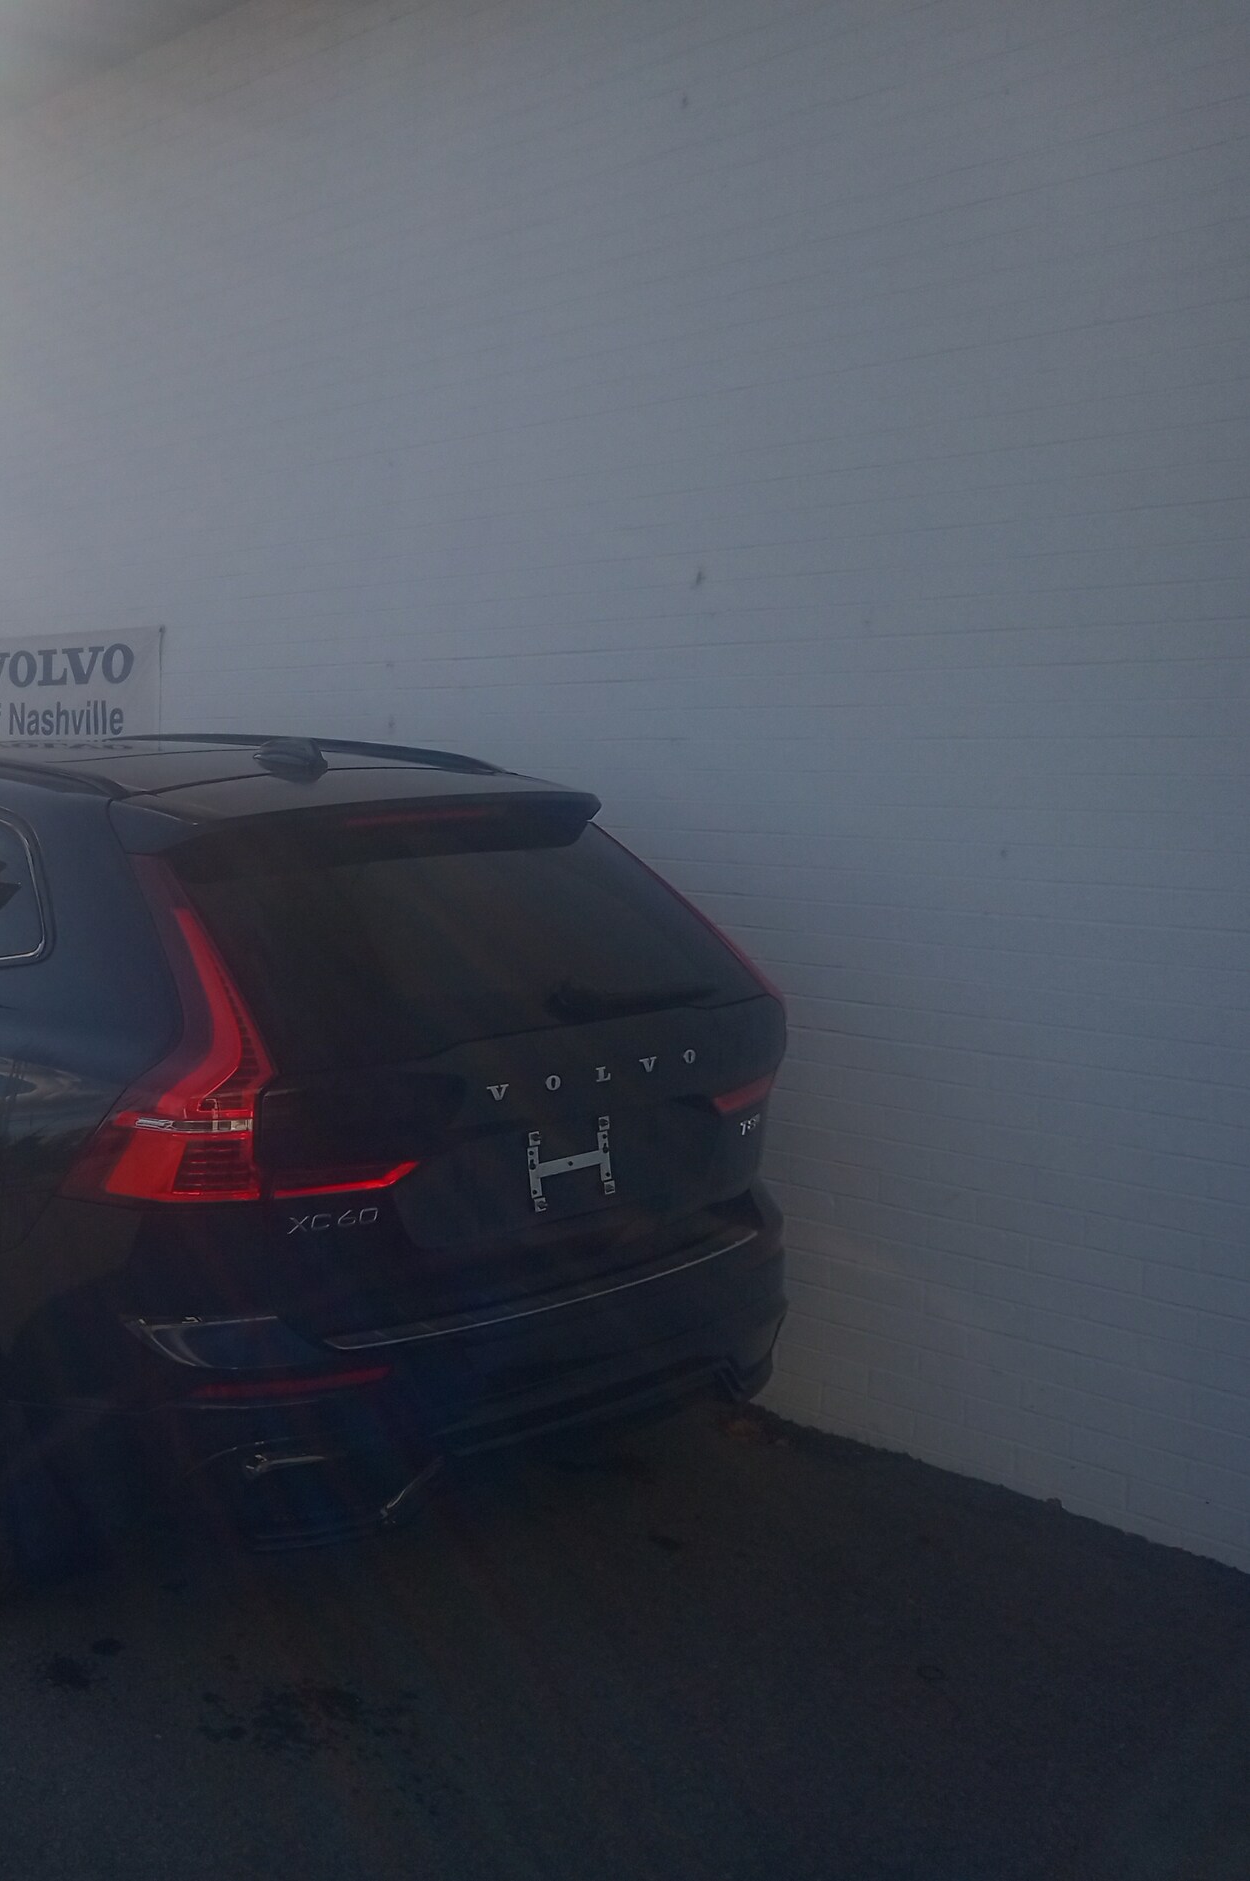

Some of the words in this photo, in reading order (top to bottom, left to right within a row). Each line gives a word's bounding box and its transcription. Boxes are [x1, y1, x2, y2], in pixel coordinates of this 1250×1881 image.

[9, 700, 124, 736] Nashville
[486, 1049, 697, 1101] VOLVO
[287, 1207, 378, 1235] XC60
